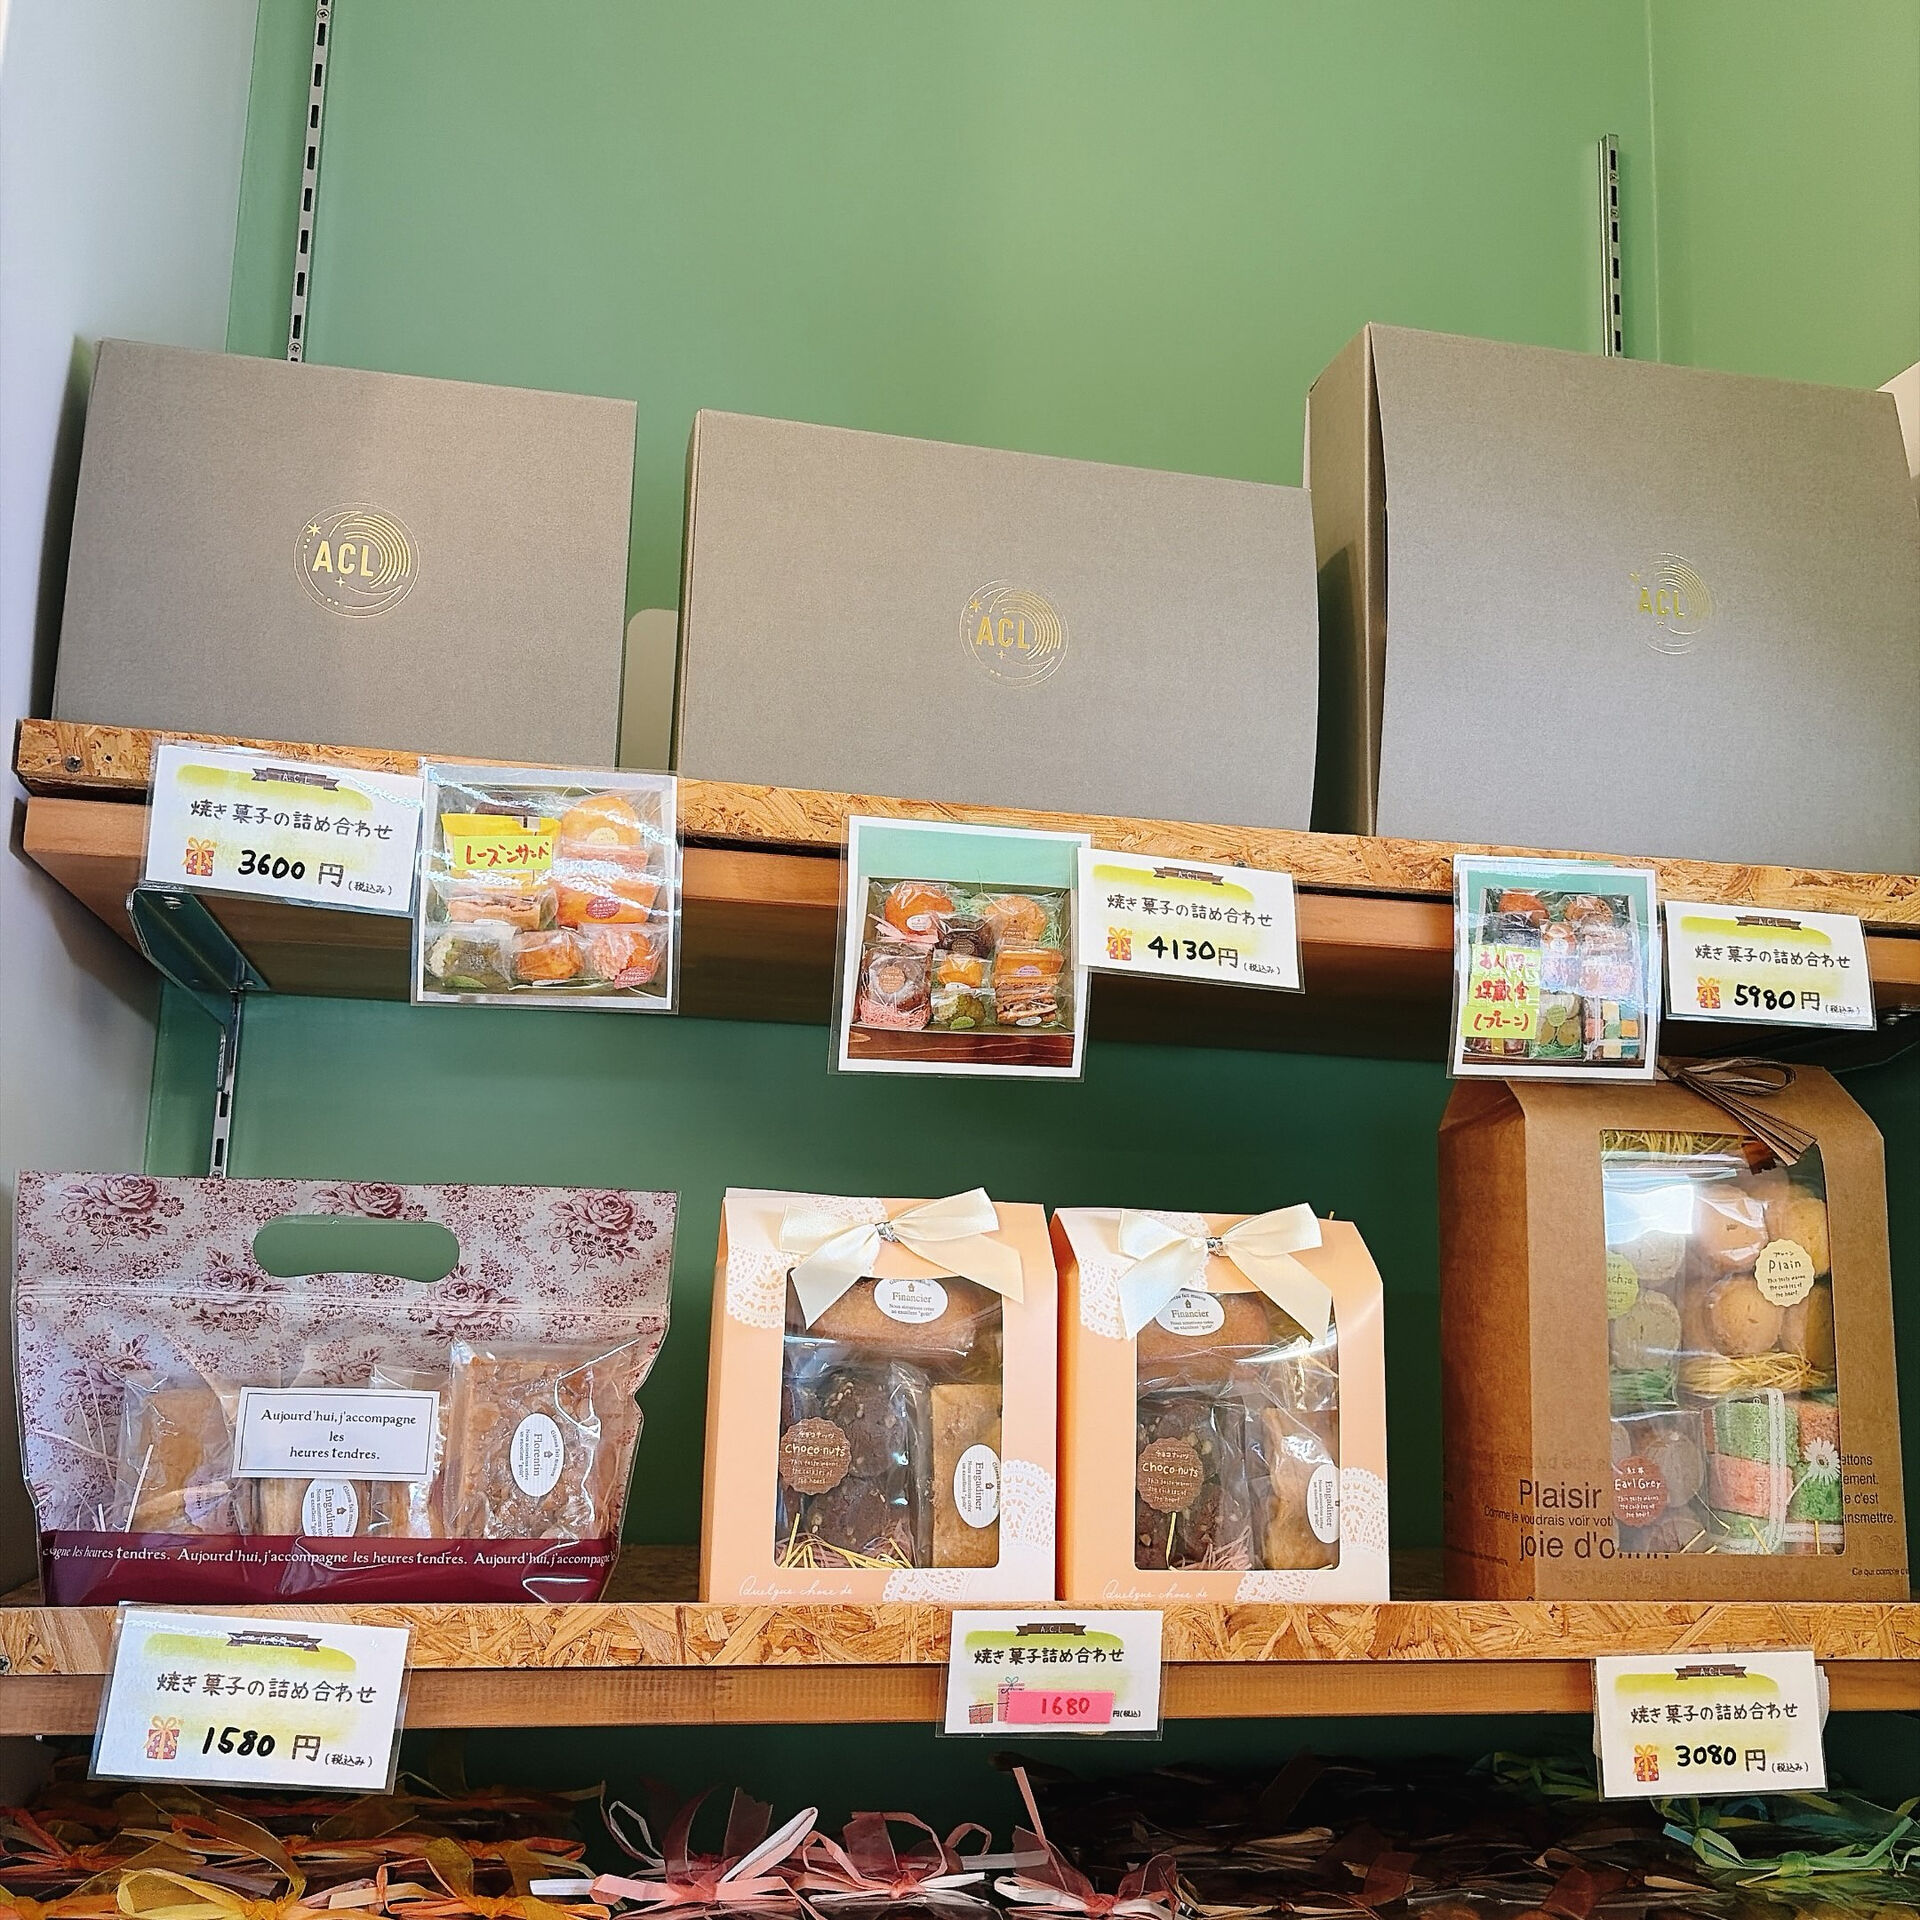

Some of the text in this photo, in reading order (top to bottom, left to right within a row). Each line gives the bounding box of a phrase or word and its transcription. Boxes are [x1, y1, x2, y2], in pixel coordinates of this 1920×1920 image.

[312, 540, 373, 577] ACL
[1638, 587, 1685, 618] ACL
[976, 616, 1030, 649] ACL
[191, 799, 393, 840] 焼き菓子の詰め合わせ
[238, 849, 305, 880] 3600
[318, 862, 344, 887] 円
[1107, 894, 1273, 927] 焼き菓子の詰め合わせ
[1147, 935, 1216, 960] 4130
[1218, 947, 1238, 968] 円
[1694, 944, 1850, 969] 焼き菓子の詰め合わせ
[1474, 979, 1529, 1002] 埋蔵金
[1734, 984, 1795, 1011] 5980
[1801, 991, 1820, 1011] 円
[1769, 1260, 1801, 1273] Plain
[260, 1409, 416, 1427] Aujourd'hui, j'accompagne
[329, 1431, 345, 1442] les
[290, 1446, 380, 1460] heures tendres.
[533, 1433, 543, 1477] Florentin
[973, 1462, 984, 1511] Engadiner
[1519, 1479, 1602, 1509] Plaisir
[1614, 1478, 1636, 1490] Earl
[1324, 1481, 1334, 1527] Engadiner
[1854, 1493, 1879, 1504] c'est
[1521, 1512, 1565, 1526] voudrais
[1568, 1513, 1590, 1526] voir
[116, 1546, 171, 1560] tendres.
[176, 1548, 261, 1566] Aujourd'hui,
[262, 1548, 347, 1566] j'accompagne
[353, 1551, 369, 1563] les
[373, 1552, 414, 1564] heures
[416, 1551, 467, 1564] tendres.
[473, 1552, 550, 1567] Aujourd'hui,
[1519, 1529, 1564, 1561] joie
[974, 1647, 1124, 1664] 焼き菓子詰め合わせ
[157, 1671, 377, 1704] 焼き菓子の詰め合わせ
[1041, 1697, 1090, 1715] 1680
[1630, 1701, 1799, 1724] 焼き菓子の詰め合わせ
[202, 1726, 276, 1757] 1580
[291, 1734, 321, 1762] 円
[1675, 1744, 1737, 1767] 3080
[1745, 1749, 1766, 1771] 円
